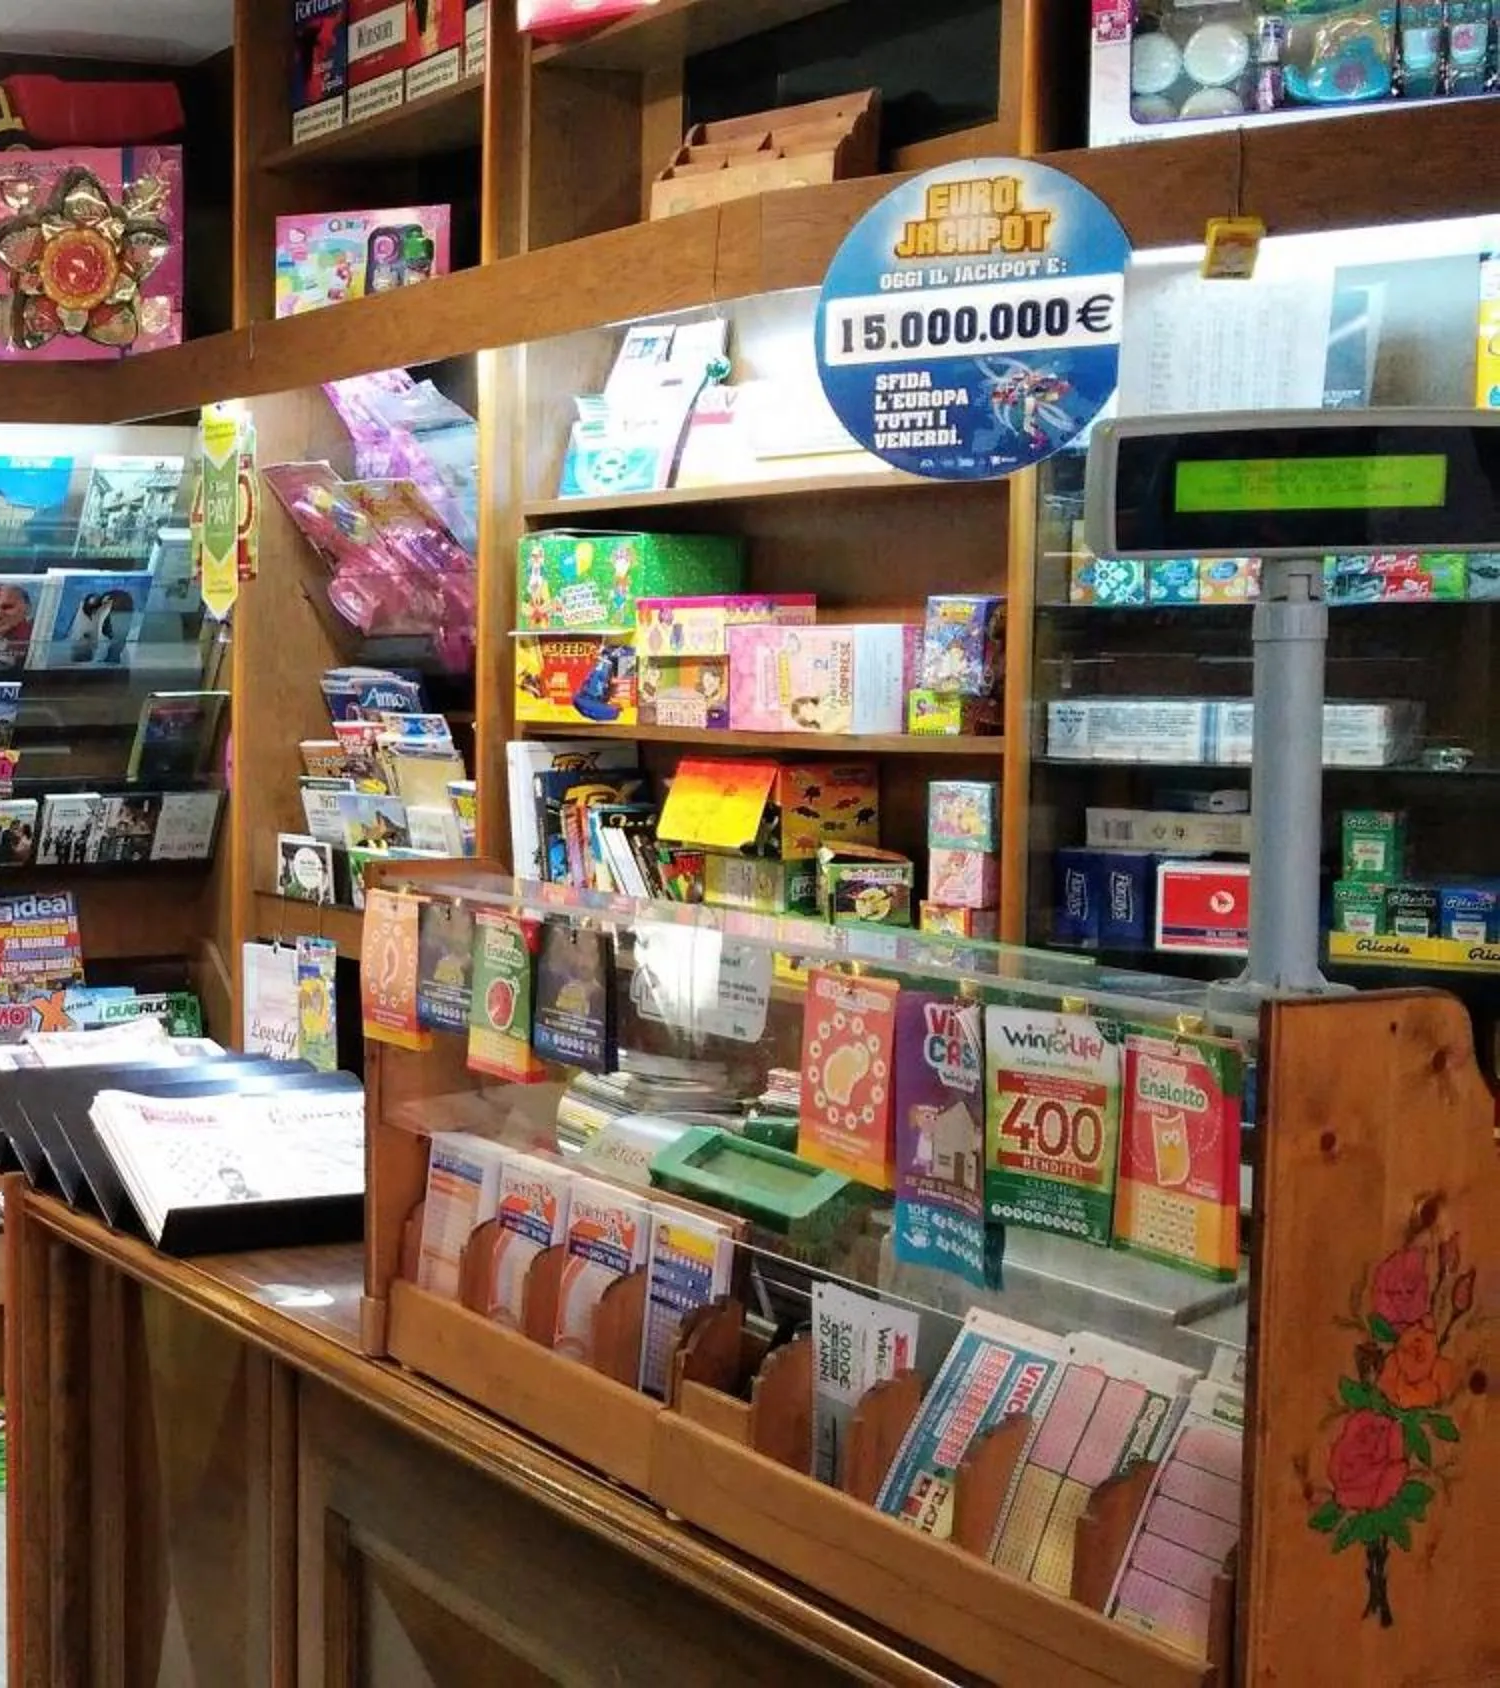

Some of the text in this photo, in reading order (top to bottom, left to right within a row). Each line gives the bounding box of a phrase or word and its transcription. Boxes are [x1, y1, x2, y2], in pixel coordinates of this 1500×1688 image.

[925, 176, 1020, 220] EURO
[895, 211, 1052, 258] JACKPOT
[880, 269, 923, 290] OGGI
[930, 266, 949, 286] IL
[954, 260, 1039, 285] JACKPOT
[841, 298, 1070, 354] 15.000.000
[875, 371, 932, 391] SFIDA
[875, 389, 969, 410] L'EUROPA
[875, 410, 935, 429] TUTTI
[251, 1017, 297, 1051] Lovely
[1139, 1078, 1206, 1108] Enalotto
[999, 1095, 1104, 1166] 400
